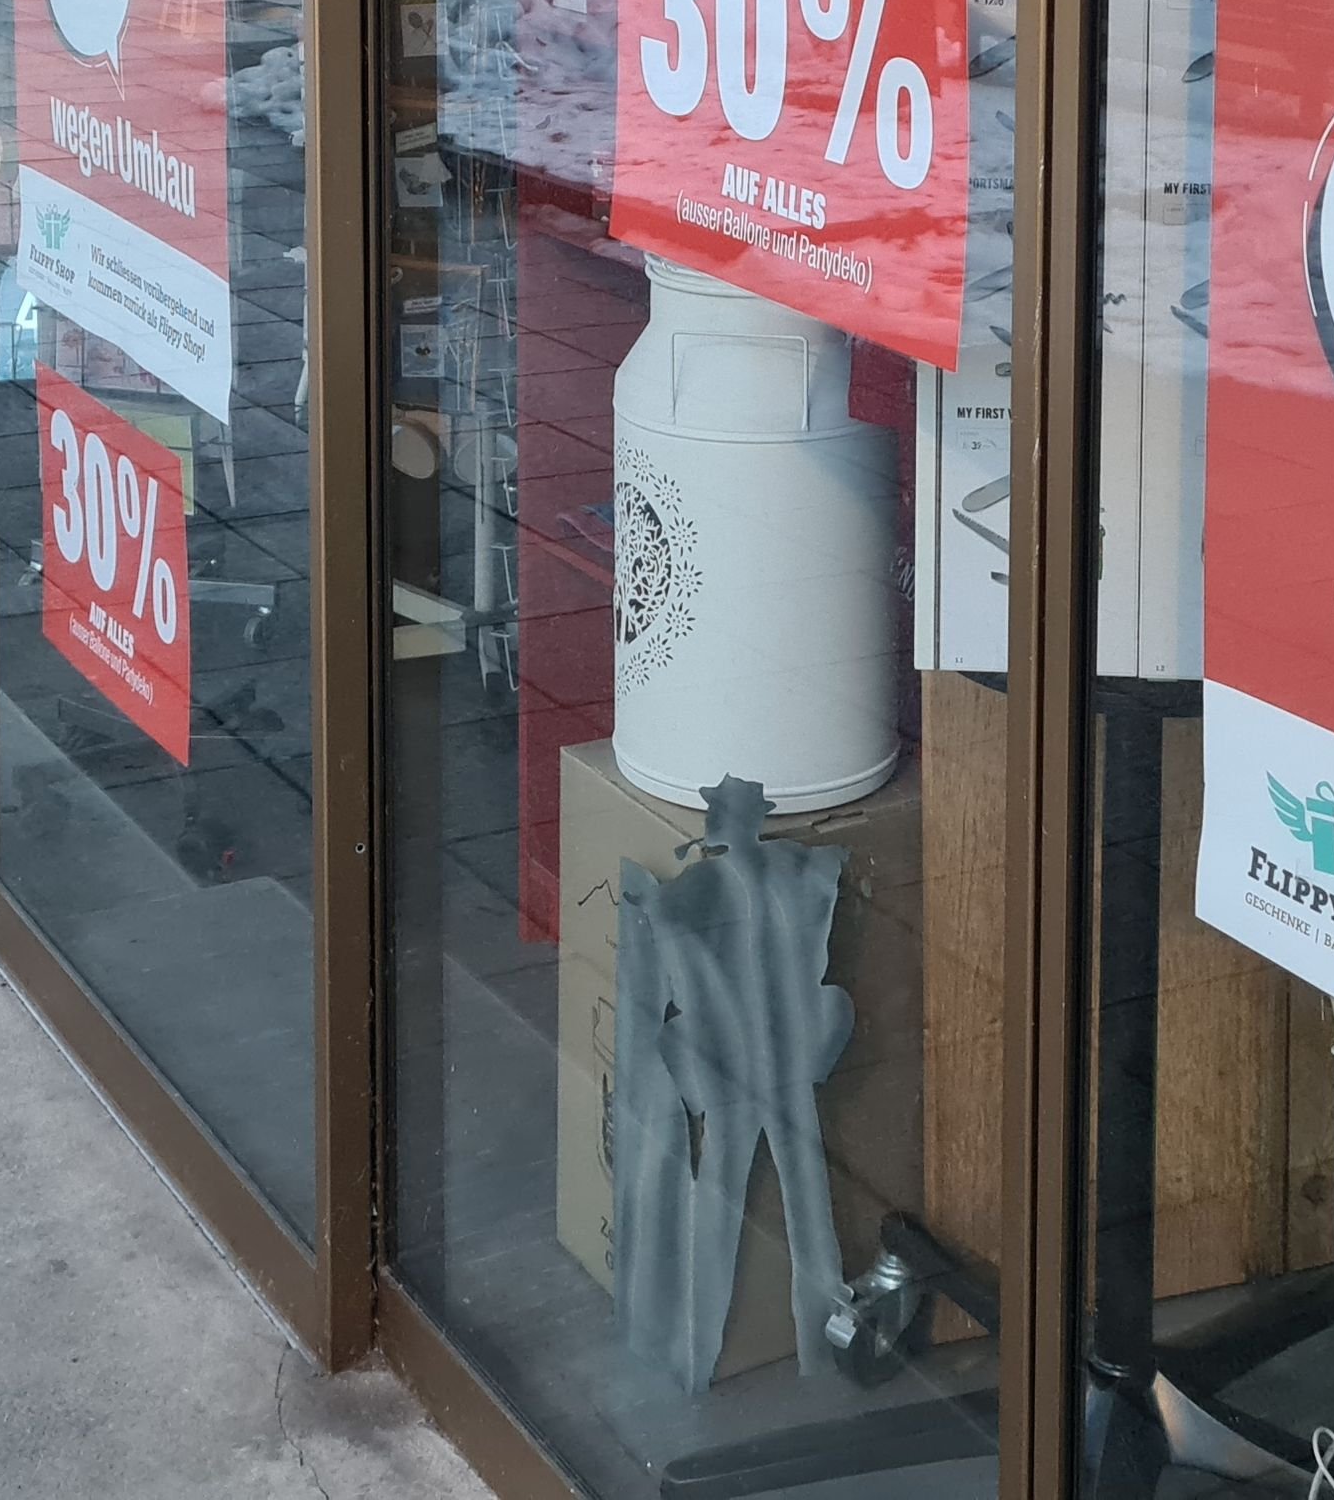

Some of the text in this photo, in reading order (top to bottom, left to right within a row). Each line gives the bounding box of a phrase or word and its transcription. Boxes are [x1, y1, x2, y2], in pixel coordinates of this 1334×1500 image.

[51, 96, 196, 218] wegen Umbau
[721, 163, 826, 230] AUF ALLES
[1164, 182, 1179, 195] MY
[676, 189, 874, 294] (ausser Ballone und Partydeko)
[88, 271, 122, 305] kommen
[147, 311, 158, 328] als
[159, 316, 182, 348] Flippy
[183, 332, 205, 363] Shop!
[91, 244, 105, 265] Wir
[106, 256, 142, 289] schliessen
[200, 314, 215, 337] und
[957, 407, 1004, 420] MY FIRST
[51, 409, 176, 645] 30%
[89, 601, 134, 659] AUF ALLES
[1245, 892, 1311, 936] GESCHENKE
